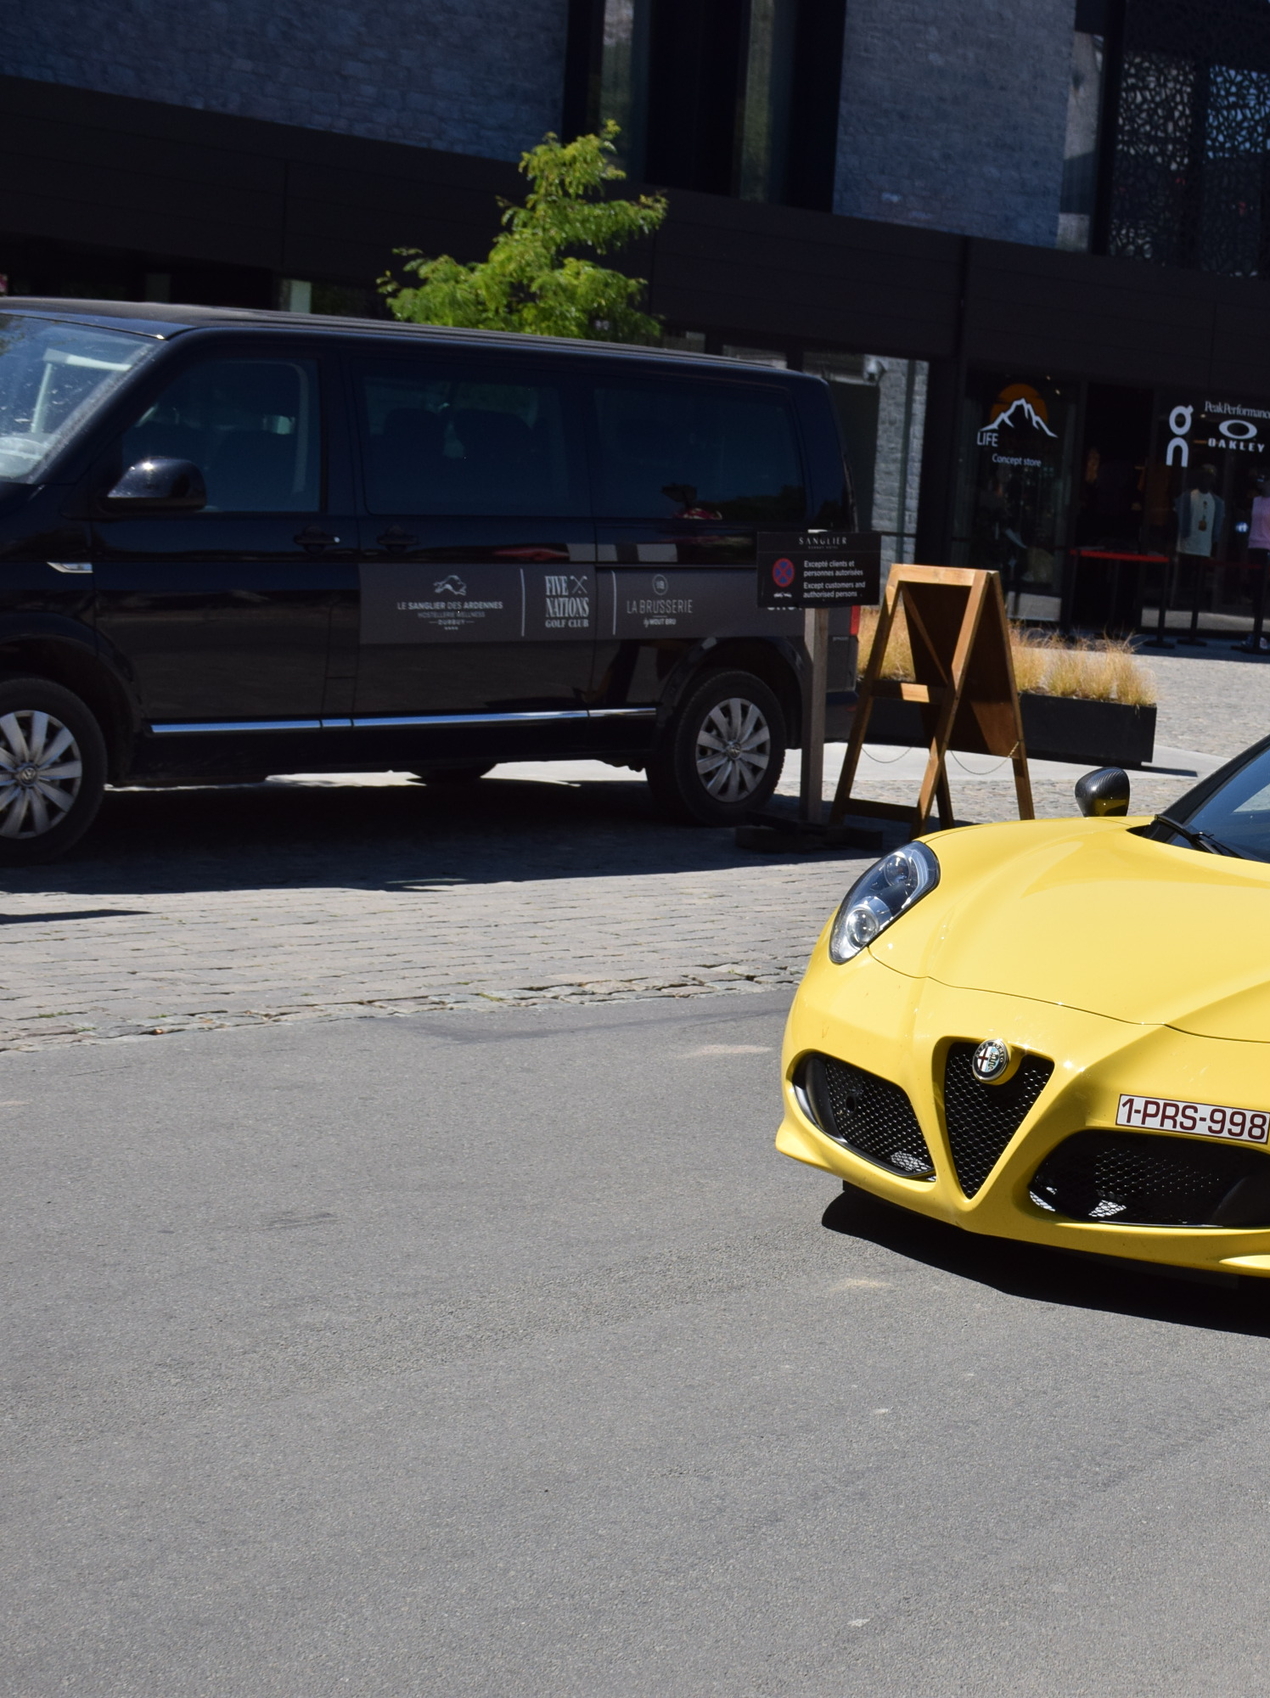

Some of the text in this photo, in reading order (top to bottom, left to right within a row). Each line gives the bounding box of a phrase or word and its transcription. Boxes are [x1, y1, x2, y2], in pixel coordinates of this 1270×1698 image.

[976, 431, 999, 447] LIFE
[1208, 438, 1265, 453] OAKLEY
[992, 453, 1042, 467] Concept store
[799, 537, 848, 545] SANGLIER
[804, 560, 855, 568] Excepté clients et
[803, 569, 863, 578] personnes autorisées
[545, 576, 568, 596] FIVE
[803, 582, 824, 590] Except
[835, 591, 858, 599] persons
[397, 601, 503, 610] LE SANGLIER DES ARDENNES
[545, 597, 589, 618] NATIONS
[626, 599, 693, 614] LA BRUSSERIE
[545, 619, 589, 628] GOLF CLUB
[1122, 1098, 1267, 1140] 1-PRS-998
